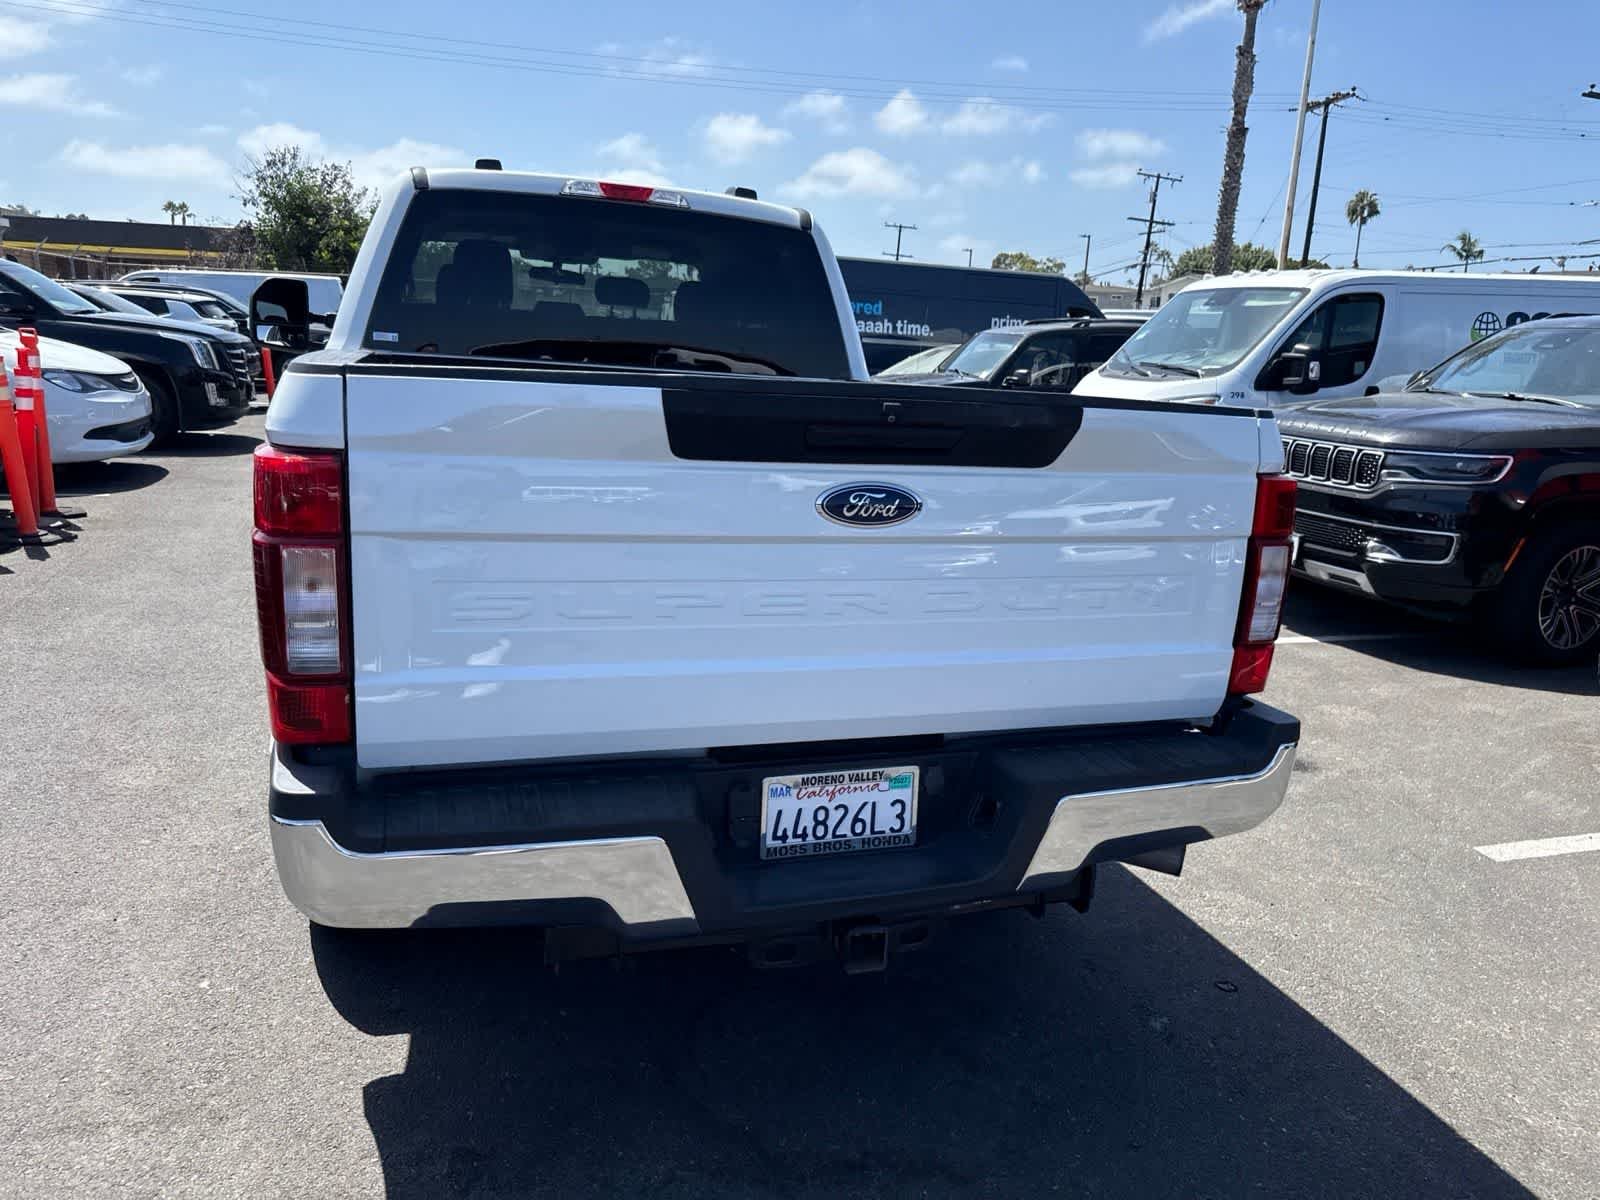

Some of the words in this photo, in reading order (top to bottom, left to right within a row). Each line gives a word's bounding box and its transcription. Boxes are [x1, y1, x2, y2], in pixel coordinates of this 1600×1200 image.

[896, 320, 934, 337] time.
[843, 492, 899, 517] Ford
[449, 588, 889, 623] SUPER
[919, 582, 1184, 613] DUTY
[801, 774, 845, 787] MORENO
[848, 771, 885, 783] VALLEY
[769, 785, 792, 798] MAR
[796, 782, 889, 802] California
[771, 799, 906, 844] 44826L3
[765, 846, 807, 857] MOSS
[813, 840, 856, 852] BROS.
[861, 834, 911, 848] HONDA
